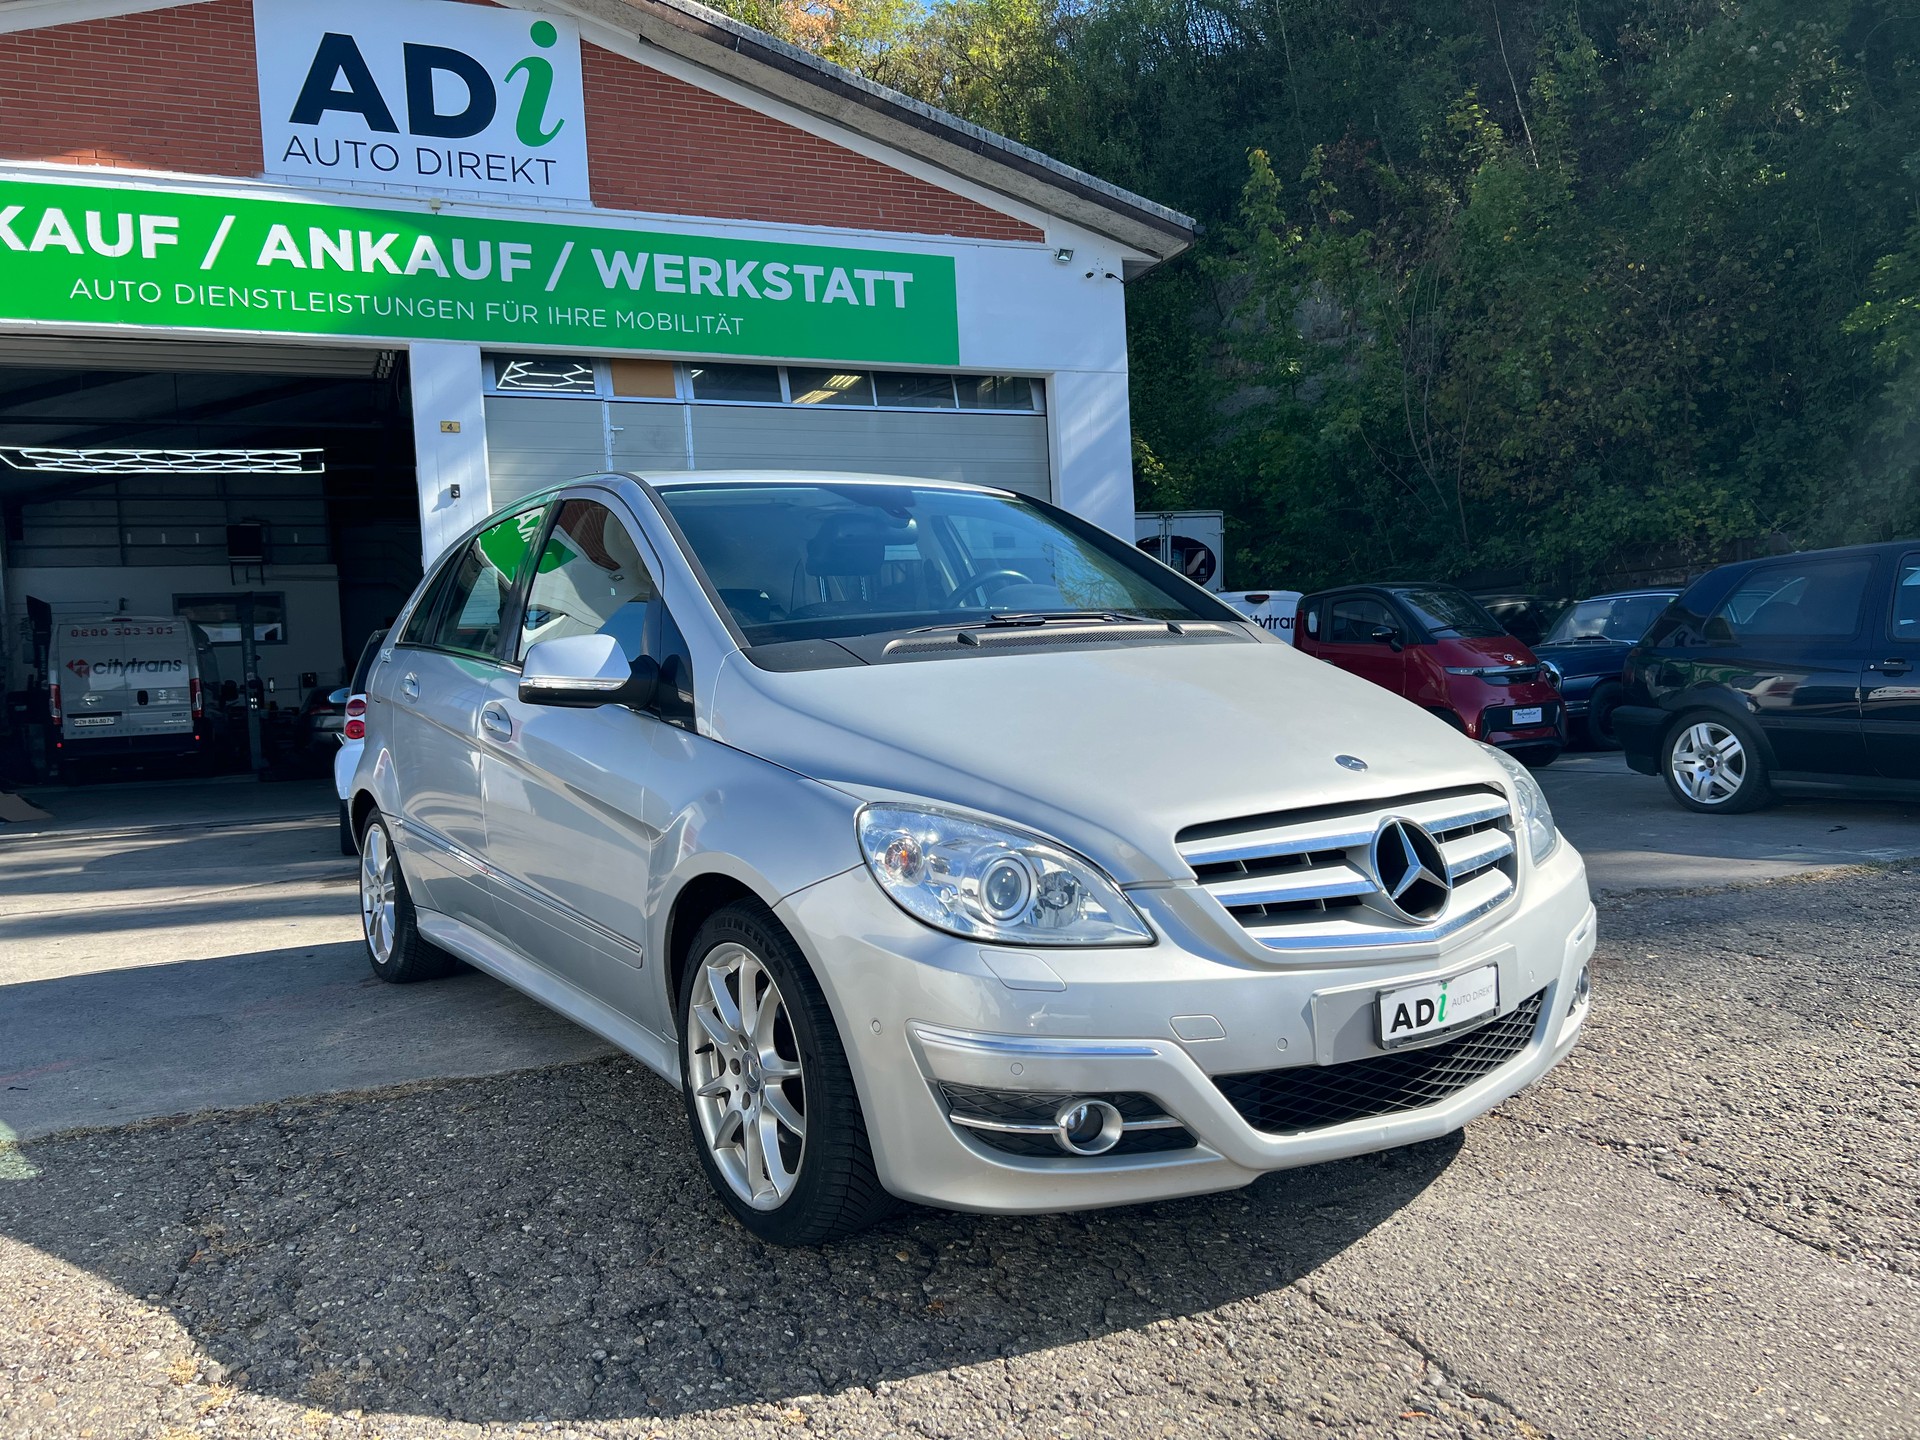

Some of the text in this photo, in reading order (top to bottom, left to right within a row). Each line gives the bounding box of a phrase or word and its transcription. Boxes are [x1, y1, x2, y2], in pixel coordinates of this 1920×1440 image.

[283, 136, 557, 186] AUTO DIREKT
[256, 223, 532, 282] ANKAUF
[591, 248, 914, 309] WERKSTATT
[69, 278, 744, 345] AUTO DIENSTLEISTUNGEN FÜR IHRE MOBILITÄT
[114, 627, 141, 636] 303
[146, 626, 173, 636] 303
[93, 658, 182, 676] citytrans
[1452, 985, 1494, 1007] AUTO DIREKT
